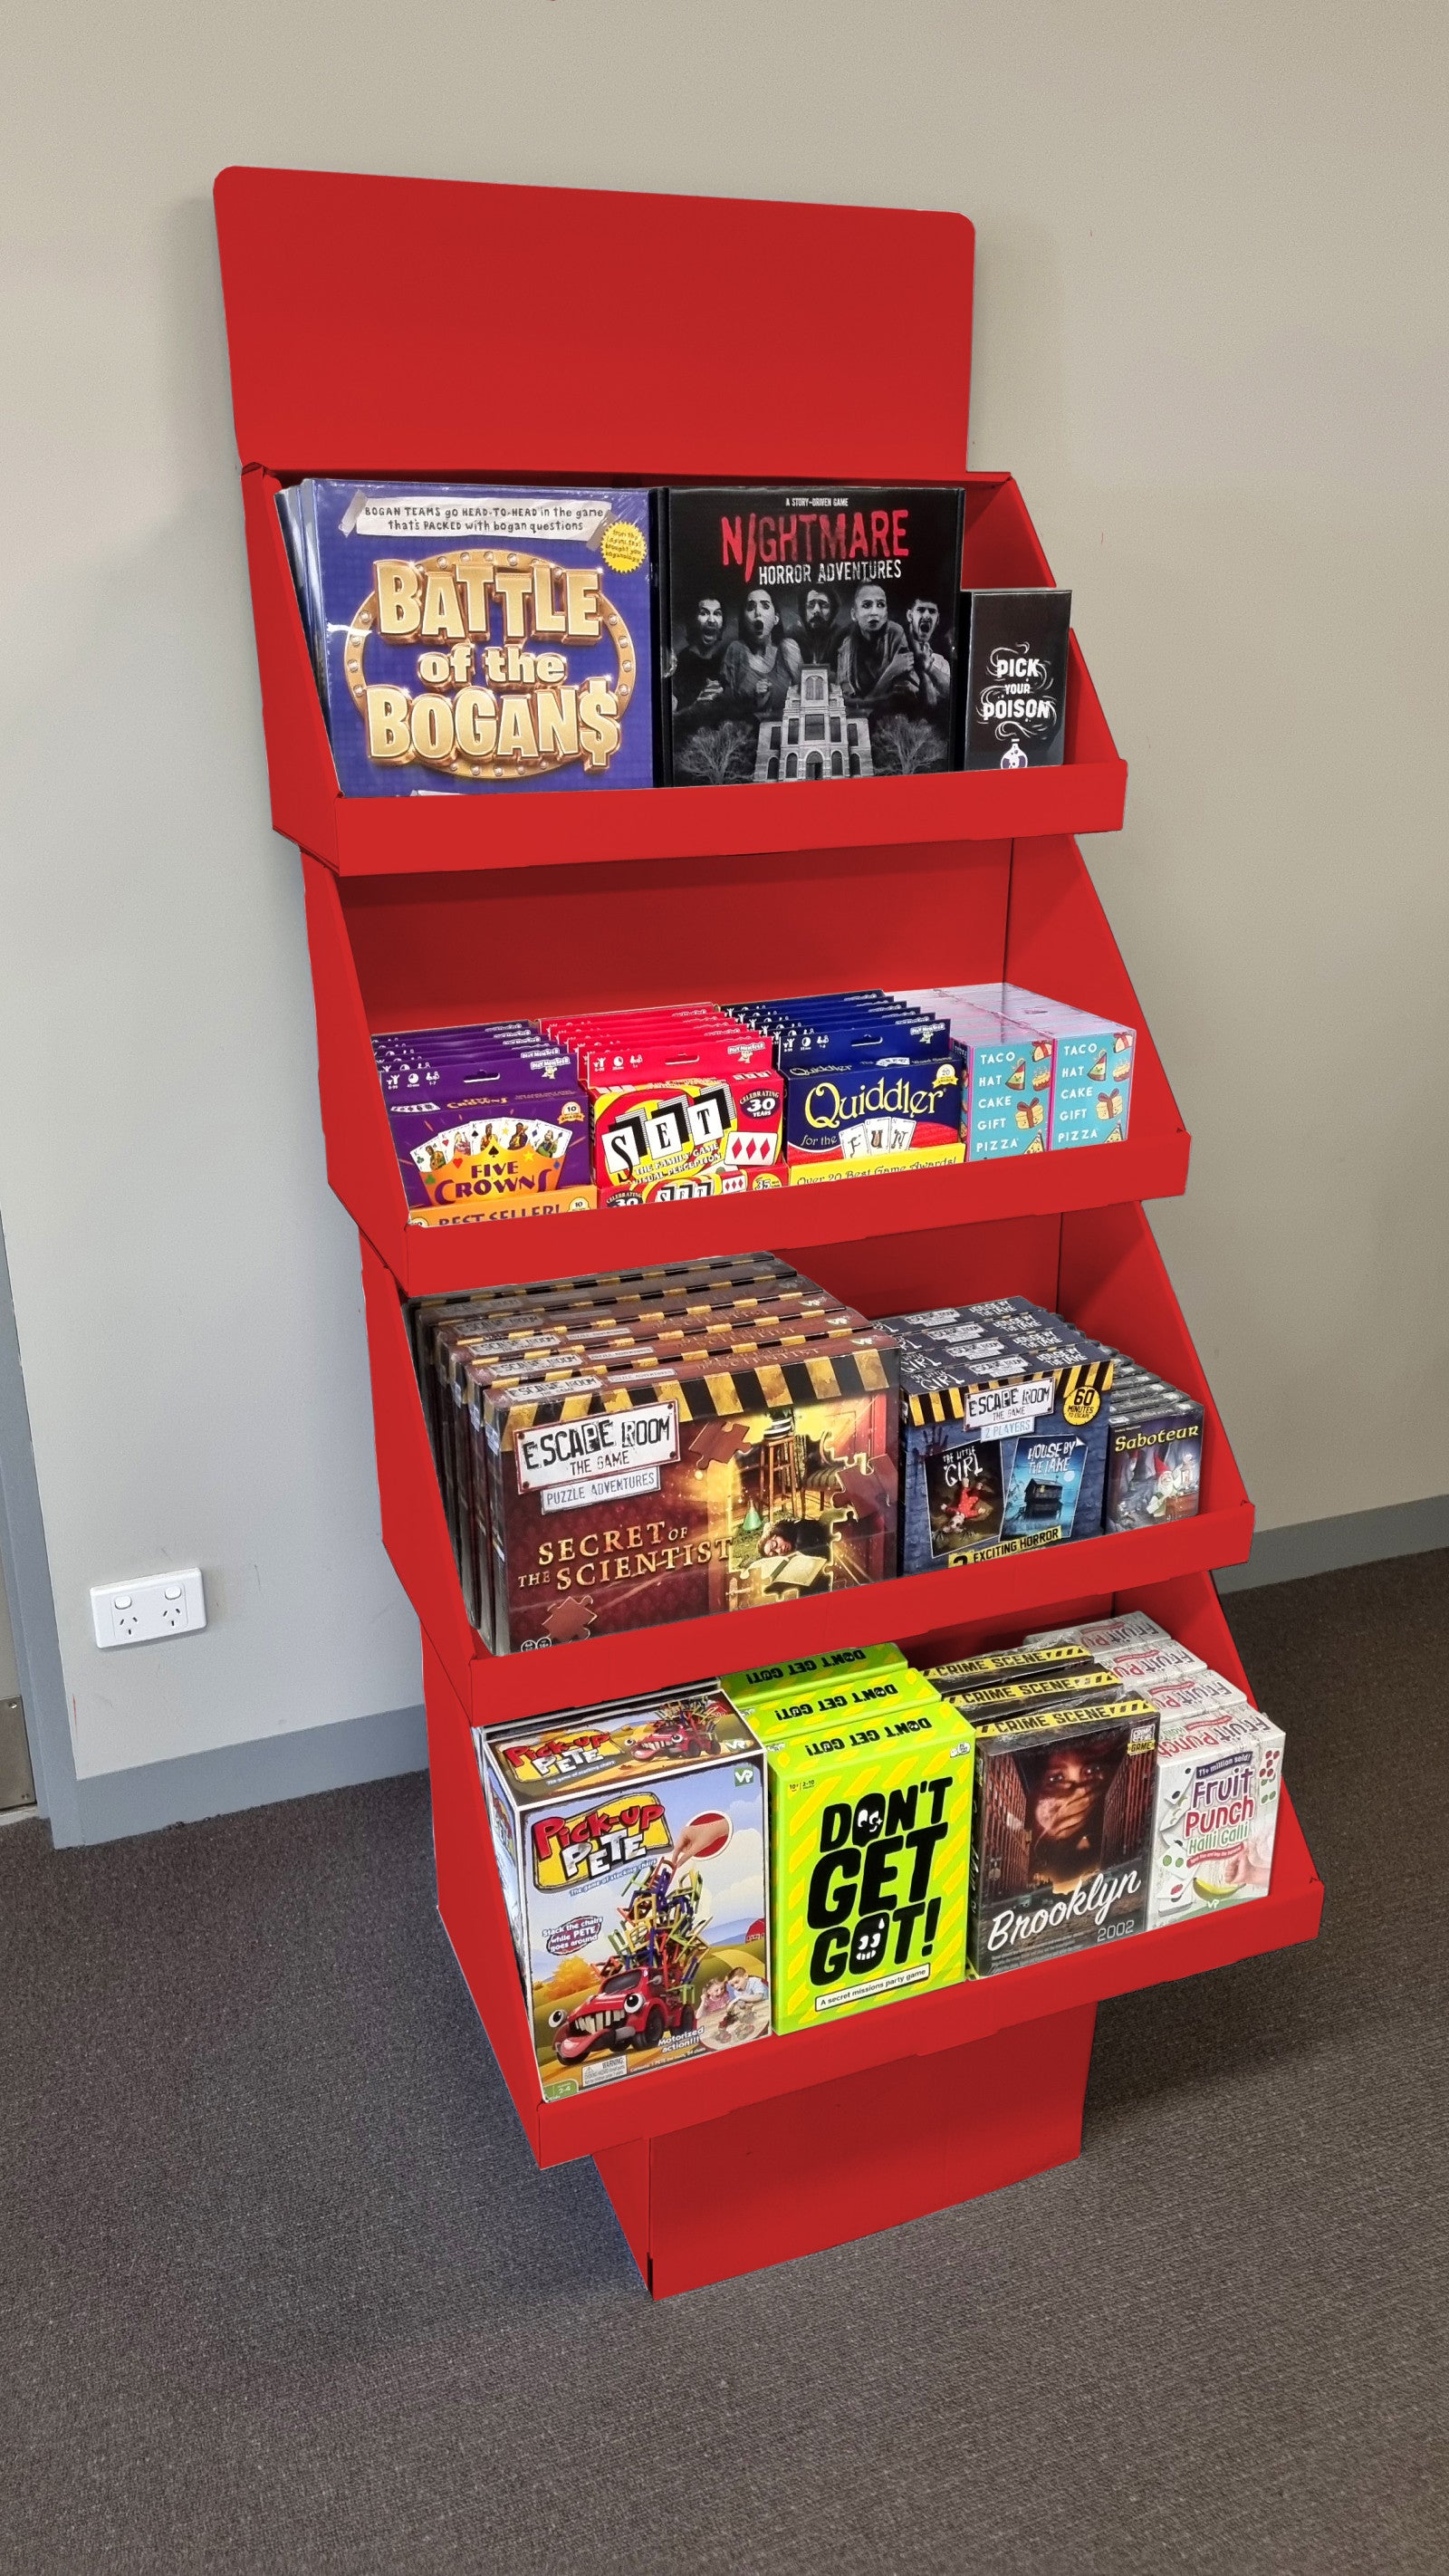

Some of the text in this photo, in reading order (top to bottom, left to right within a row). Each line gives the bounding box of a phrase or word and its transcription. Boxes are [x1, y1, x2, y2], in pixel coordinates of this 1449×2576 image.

[365, 506, 604, 520] BOGAN TEAMS go HEAD-TO-HEAD in the game
[785, 497, 849, 507] A STORY-DRIVEN GAME
[388, 518, 584, 534] that's PACKED with bogan questions
[721, 509, 909, 582] NIGHTMARE
[758, 559, 902, 585] HORROR ADVENTURES
[374, 559, 604, 643] BATTLE
[417, 644, 570, 690] of the
[995, 657, 1041, 678] PICK
[1004, 683, 1031, 695] YOUR
[982, 699, 1052, 722] POISON
[364, 677, 621, 773] BOGAN$
[980, 1051, 1016, 1064] TACO
[1064, 1043, 1098, 1055] TACO
[979, 1074, 1003, 1087] HAT
[1061, 1066, 1085, 1078] HAT
[739, 1091, 781, 1105] CELEBRATING
[746, 1099, 777, 1113] 30
[804, 1076, 945, 1129] Quiddler
[978, 1095, 1012, 1109] CAKE
[1060, 1087, 1094, 1100] CAKE
[753, 1109, 772, 1117] YEARS
[977, 1118, 1007, 1130] GIFT
[1060, 1108, 1088, 1121] GIFT
[610, 1108, 711, 1183] SET
[800, 1129, 908, 1159] for the FUN
[976, 1138, 1018, 1153] PIZZA
[1058, 1129, 1099, 1143] PIZZA
[470, 1160, 520, 1179] FIVE
[632, 1152, 723, 1186] VISUAL PERCEPTION
[636, 1142, 720, 1176] THE FAMILY GAME
[797, 1157, 957, 1185] Over 20 Best Game Awards!
[433, 1168, 552, 1206] CROWNS
[567, 1376, 603, 1390] ROOM
[969, 1386, 1051, 1418] ESCAPE ROOM
[1067, 1405, 1094, 1414] MINUTES
[1073, 1389, 1096, 1406] 60
[993, 1406, 1026, 1421] THE GAME
[993, 1419, 1032, 1437] PLAYERS
[1114, 1425, 1200, 1452] Saboteur
[522, 1415, 671, 1470] ESCAPE ROOM
[943, 1446, 976, 1465] THE LITTLE
[1027, 1441, 1078, 1460] HOUSE BY
[570, 1449, 629, 1476] THE GAME
[944, 1453, 984, 1487] GIRL
[1028, 1456, 1070, 1475] THE LAKE
[546, 1472, 656, 1505] PUZZLE ADVENTURES
[539, 1521, 688, 1566] SECRET OF
[973, 1528, 1060, 1562] EXCITING HORROR
[518, 1536, 734, 1591] THE SCIENTIST
[746, 1649, 868, 1685] DON'T GET GOT!
[936, 1651, 1045, 1677] CRIME SCENE
[774, 1684, 899, 1722] DON'T GET GOT!
[964, 1678, 1072, 1705] CRIME SCENE
[1176, 1680, 1233, 1708] Fruit
[994, 1706, 1108, 1734] CRIME SCENE
[1214, 1715, 1271, 1743] Fruit
[804, 1716, 933, 1757] DON'T GET GOT!
[1130, 1742, 1153, 1753] GAME
[1156, 1731, 1220, 1758] Punch
[530, 1747, 605, 1776] PETE
[1210, 1758, 1233, 1773] million
[1233, 1754, 1252, 1764] sold!
[1192, 1767, 1254, 1810] Fruit
[820, 1776, 954, 1854] DON'T
[1184, 1794, 1255, 1838] Punch
[1188, 1831, 1217, 1855] Halli
[1221, 1821, 1249, 1844] Galli
[558, 1828, 648, 1880] PETE
[806, 1821, 949, 1931] GET
[986, 1869, 1143, 1952] Brooklyn
[542, 1917, 603, 1937] Stack the chairs
[550, 1926, 596, 1944] while PETE
[1096, 1919, 1136, 1943] 2002
[550, 1935, 598, 1953] goes around
[810, 1898, 943, 1986] GOT!
[827, 1993, 850, 2004] secret
[851, 1983, 884, 1996] missions
[885, 1975, 905, 1989] party
[906, 1968, 926, 1981] game
[657, 2025, 705, 2047] Motorized
[661, 2035, 700, 2054] action!!!
[601, 2057, 625, 2070] WARNING:
